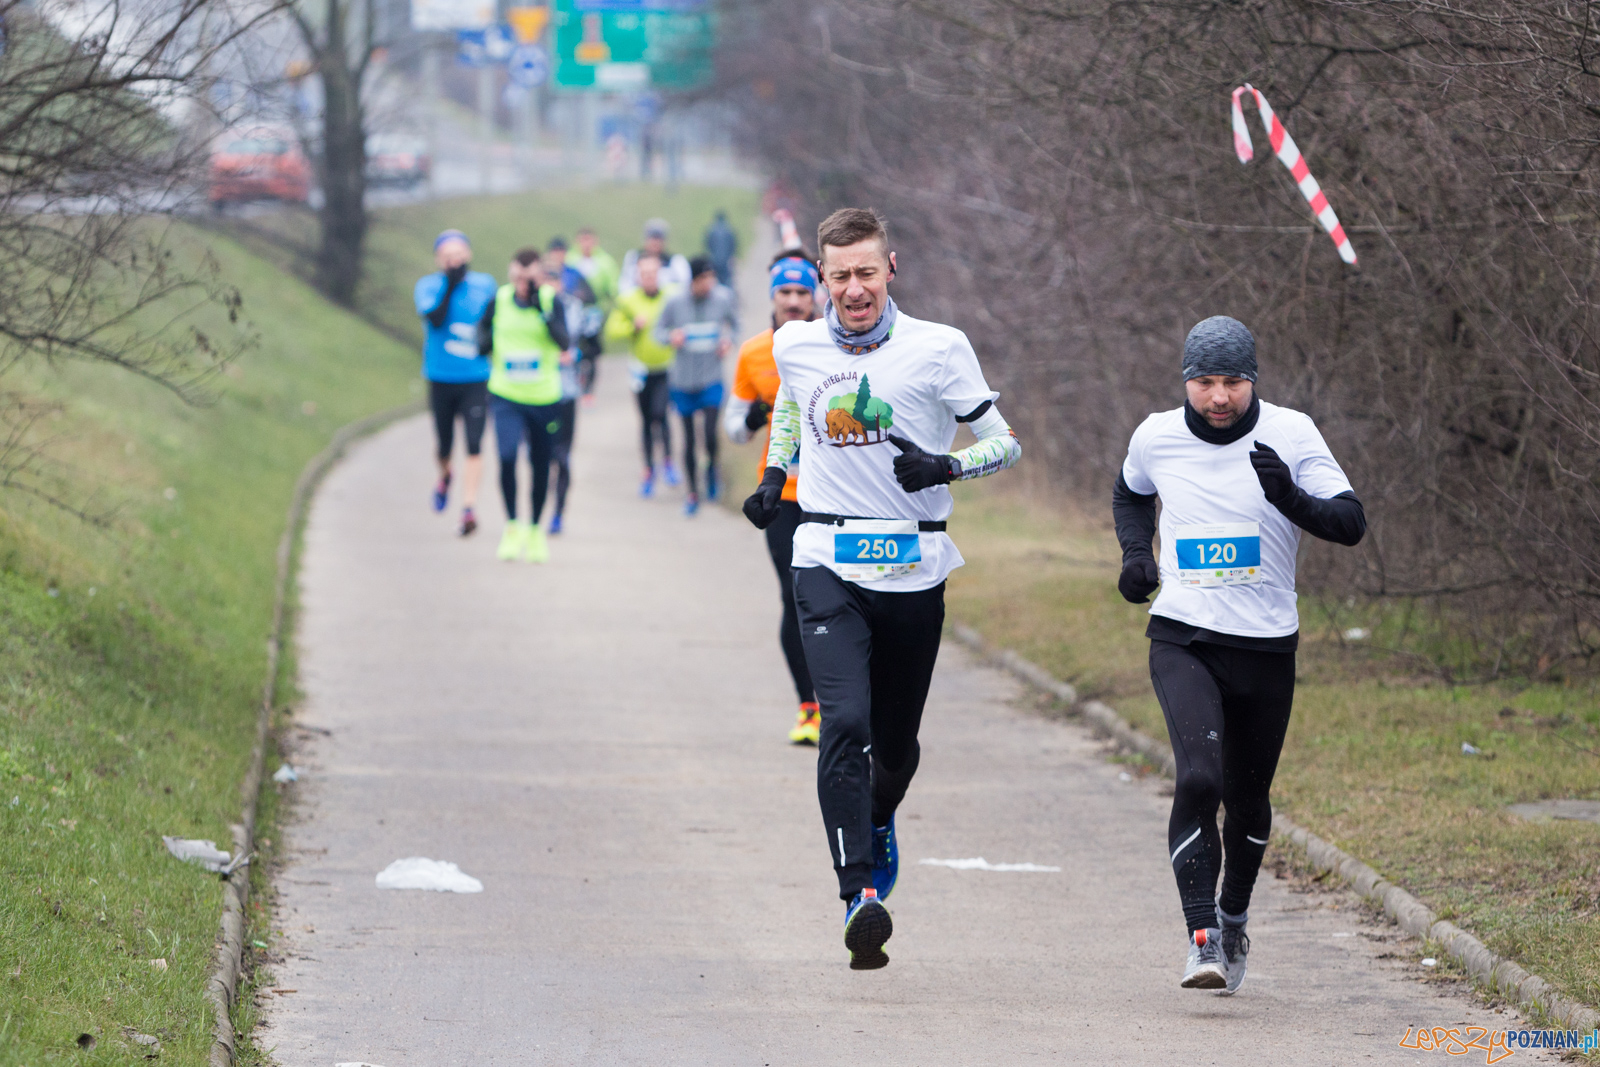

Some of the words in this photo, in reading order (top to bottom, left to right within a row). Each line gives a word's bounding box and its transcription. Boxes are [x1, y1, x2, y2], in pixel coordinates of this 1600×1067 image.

[823, 371, 857, 389] BIEGAJĄ
[857, 539, 898, 559] 250
[1197, 543, 1237, 564] 120
